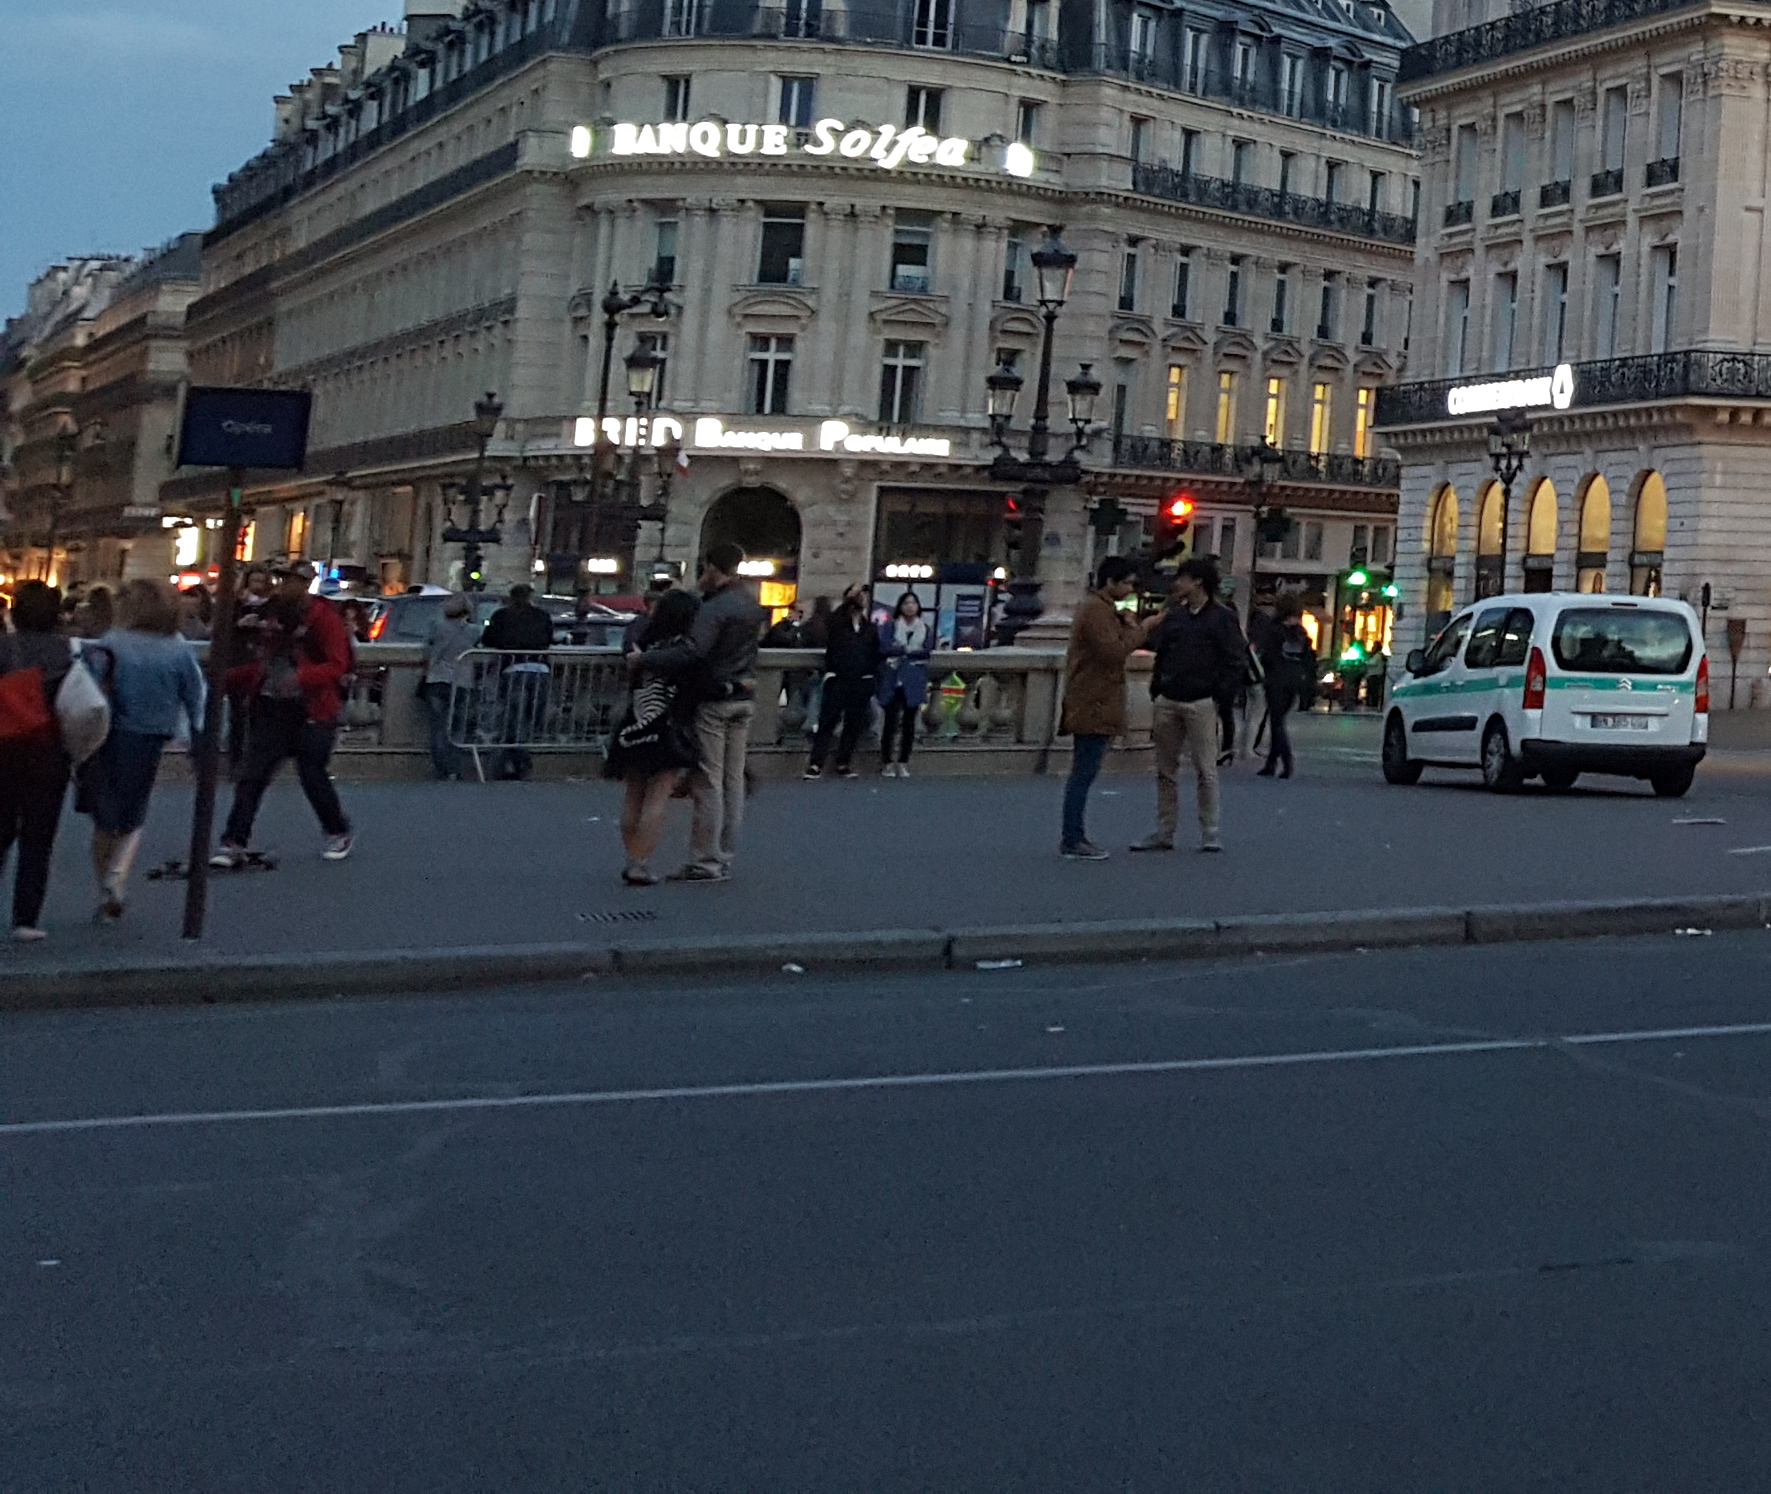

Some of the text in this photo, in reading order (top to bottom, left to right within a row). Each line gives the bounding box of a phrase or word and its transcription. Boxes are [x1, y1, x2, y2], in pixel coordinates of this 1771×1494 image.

[611, 118, 969, 169] BANQUE Solfea
[574, 417, 683, 448] BRED
